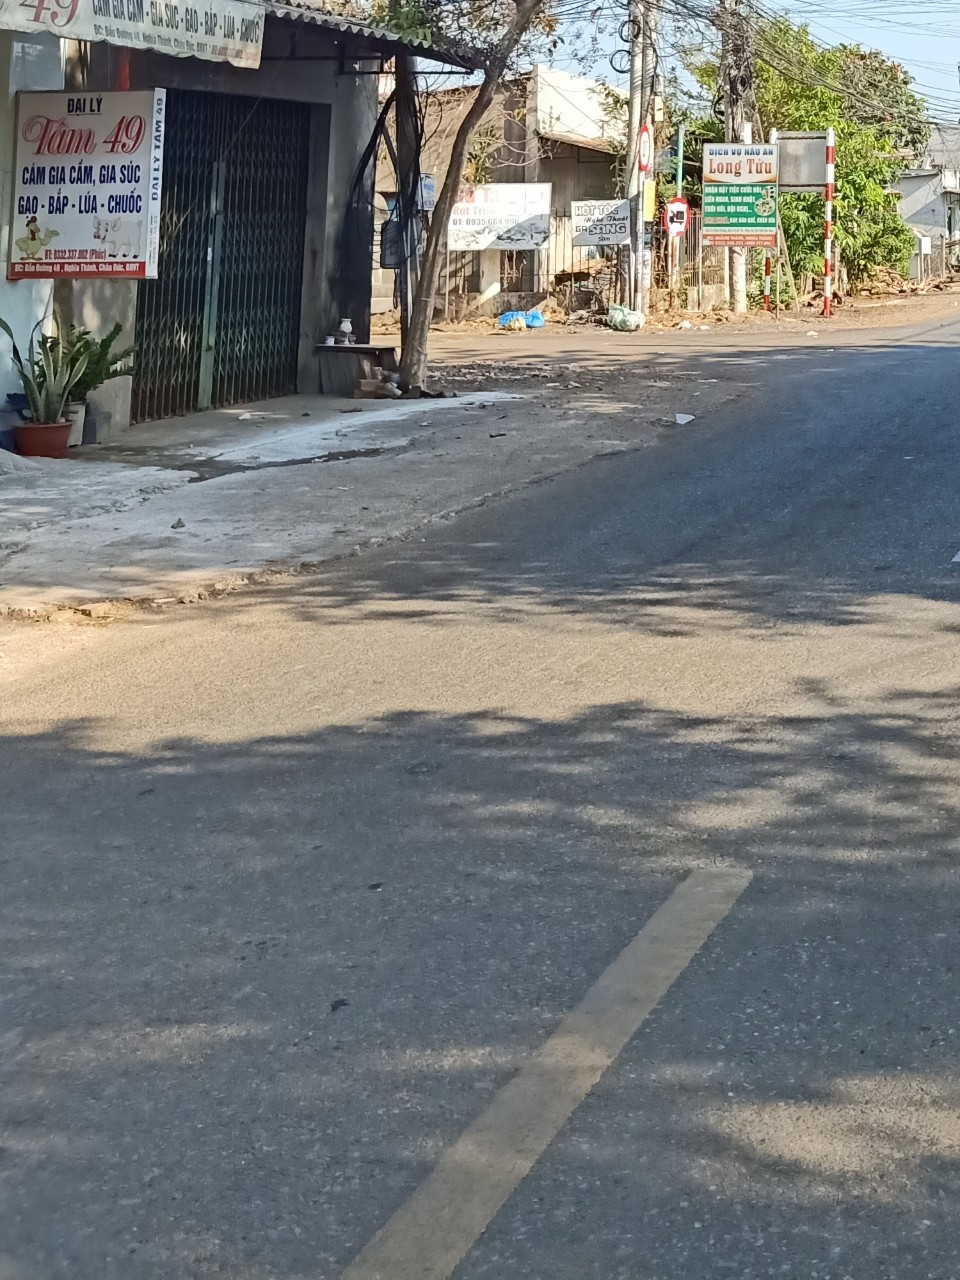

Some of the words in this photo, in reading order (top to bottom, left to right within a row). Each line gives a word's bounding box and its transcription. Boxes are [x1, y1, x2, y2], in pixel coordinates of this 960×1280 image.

[150, 0, 164, 28] GIA
[185, 6, 199, 39] GẠO
[67, 98, 86, 117] ĐẠI
[89, 95, 103, 114] LÝ
[102, 114, 147, 156] 49
[21, 162, 46, 186] CÁM
[48, 165, 66, 185] GIA
[98, 164, 117, 184] GIA
[119, 160, 141, 184] SÚC
[708, 158, 742, 178] Long
[17, 195, 39, 219] GẠO
[47, 187, 69, 215] BẮP
[78, 190, 98, 214] LÚA
[107, 187, 143, 214] CHUỐC
